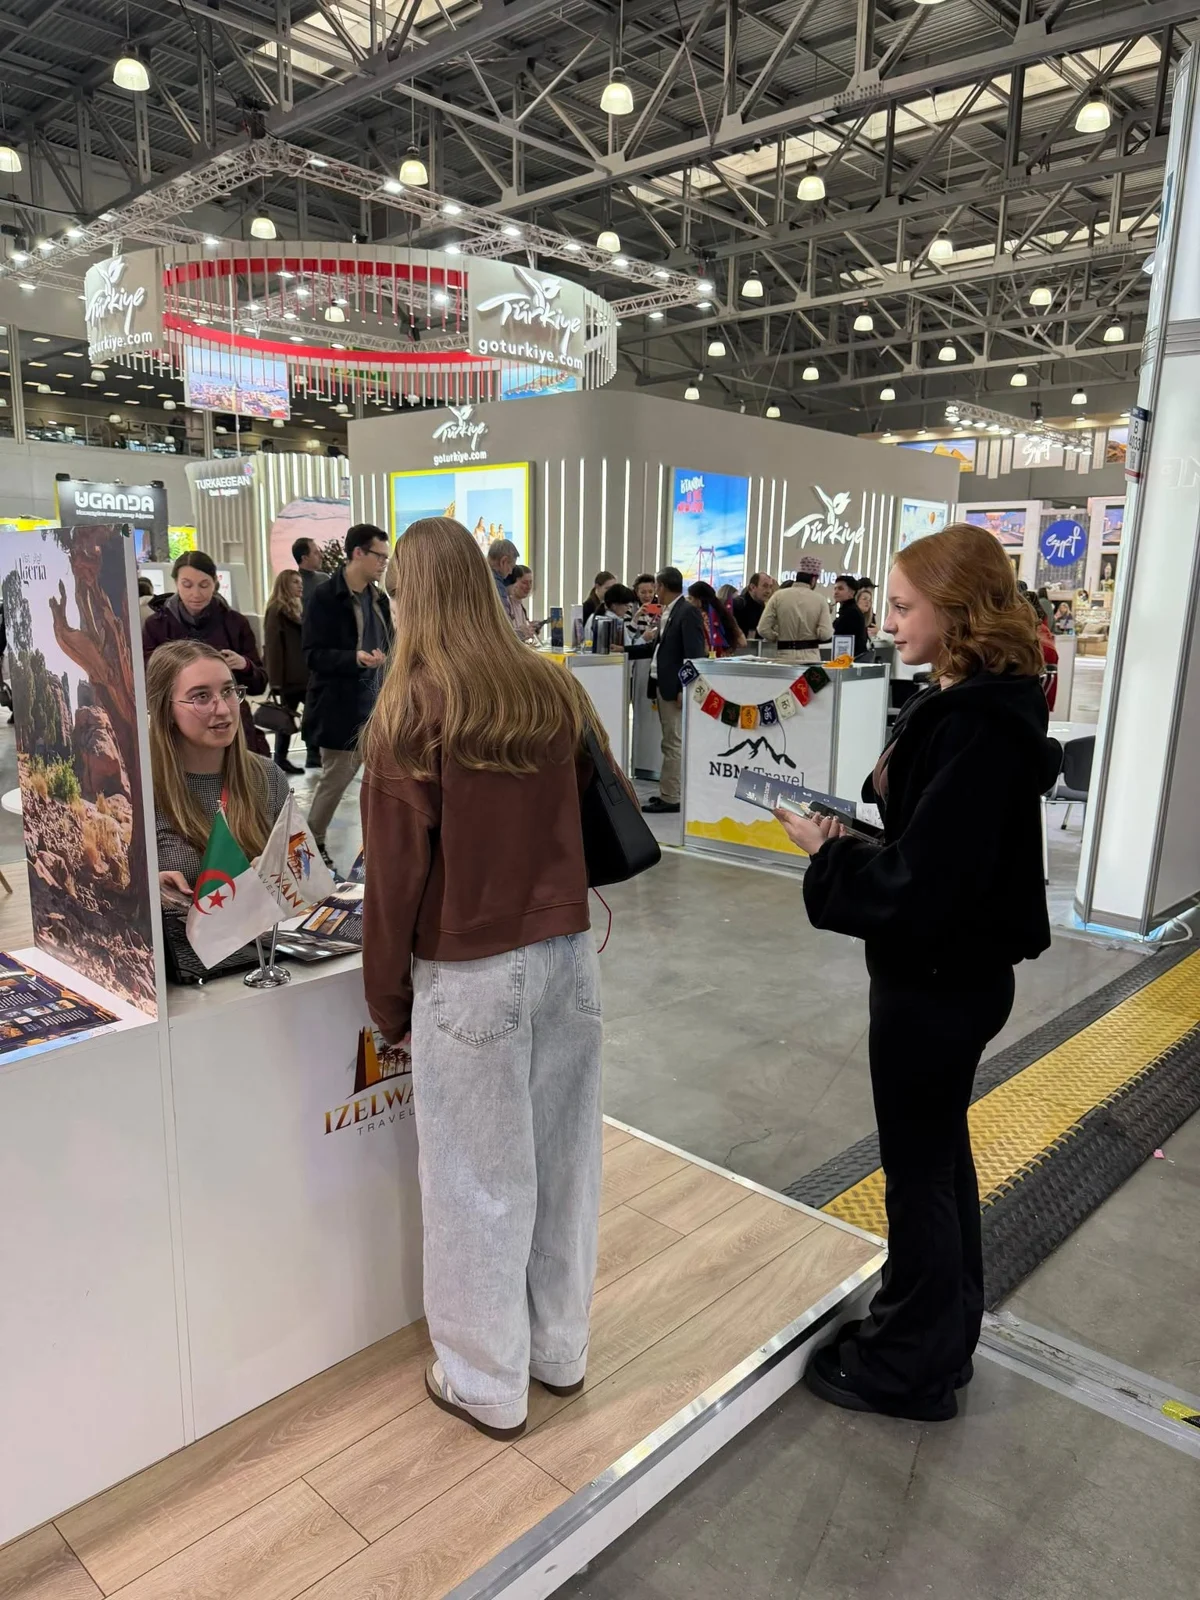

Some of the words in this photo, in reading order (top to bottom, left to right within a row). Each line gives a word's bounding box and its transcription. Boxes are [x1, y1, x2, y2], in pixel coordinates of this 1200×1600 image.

[476, 293, 582, 356] Türkiye
[478, 338, 583, 369] goturkiye.com
[433, 451, 487, 466] goturkiye.com
[195, 475, 251, 490] TURKAEGEAN
[74, 490, 155, 513] UGANDA
[356, 1108, 416, 1136] TRAVEL
